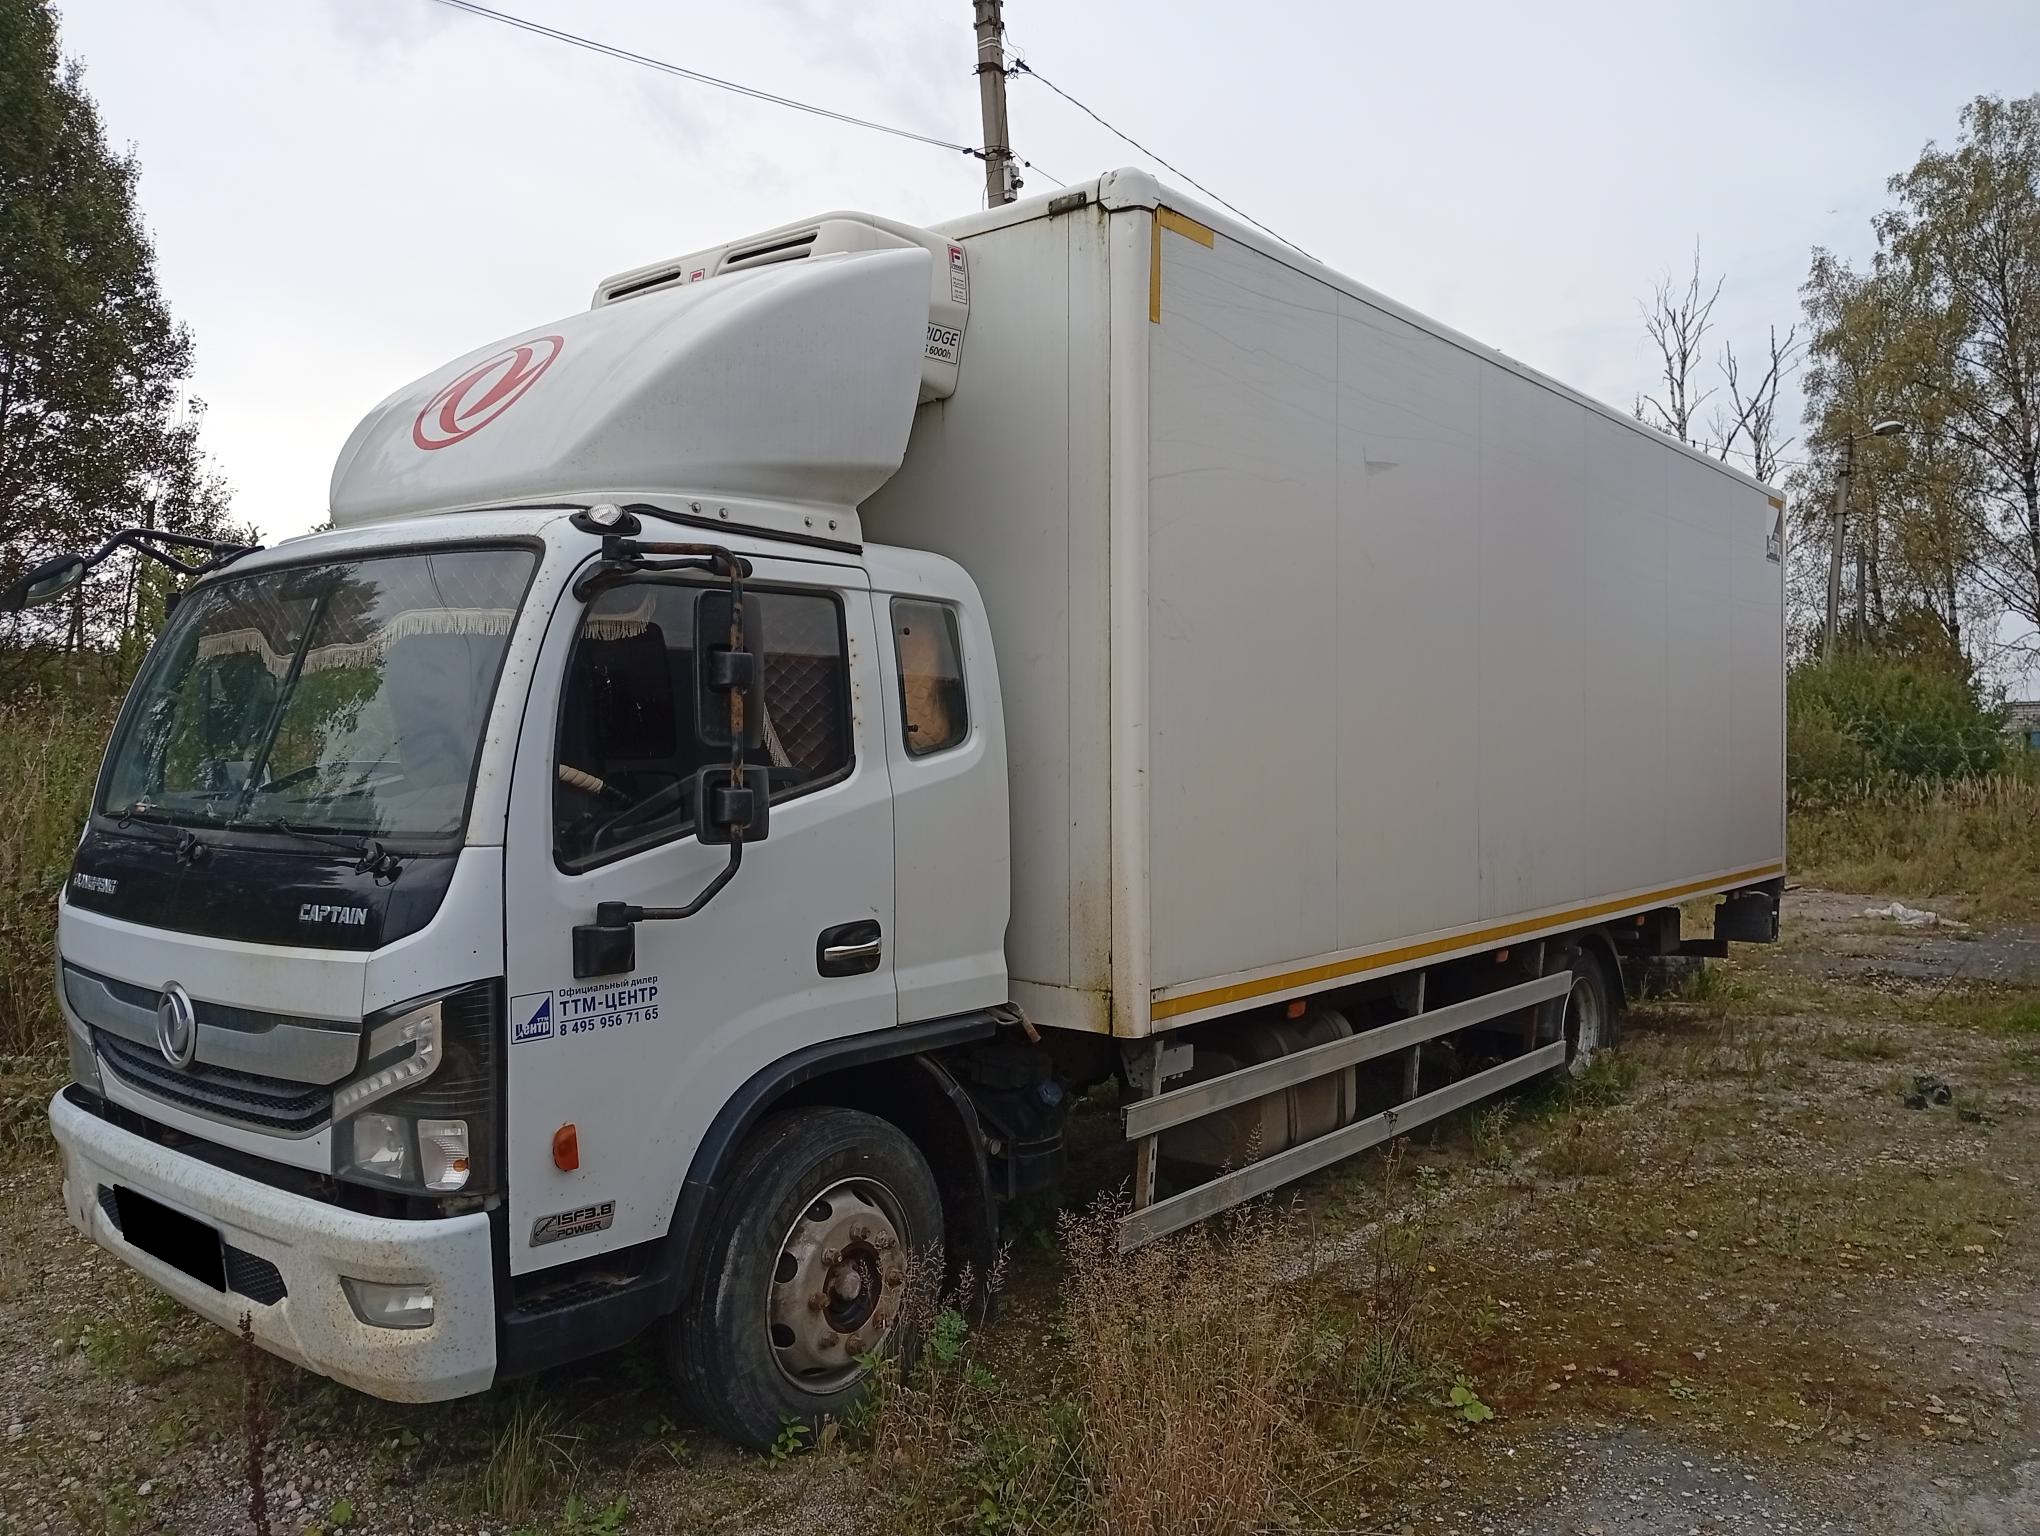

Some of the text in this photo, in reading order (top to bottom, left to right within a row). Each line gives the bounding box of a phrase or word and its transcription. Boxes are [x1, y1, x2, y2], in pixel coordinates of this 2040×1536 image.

[929, 345, 952, 359] 6000h
[299, 903, 369, 925] CAPTAIN
[559, 976, 658, 998] Официальный дилер
[559, 986, 659, 1016] ТТМ-ЦЕНТР
[560, 1008, 659, 1036] 8 495 956 71 65
[557, 1204, 612, 1225] ISF3.8
